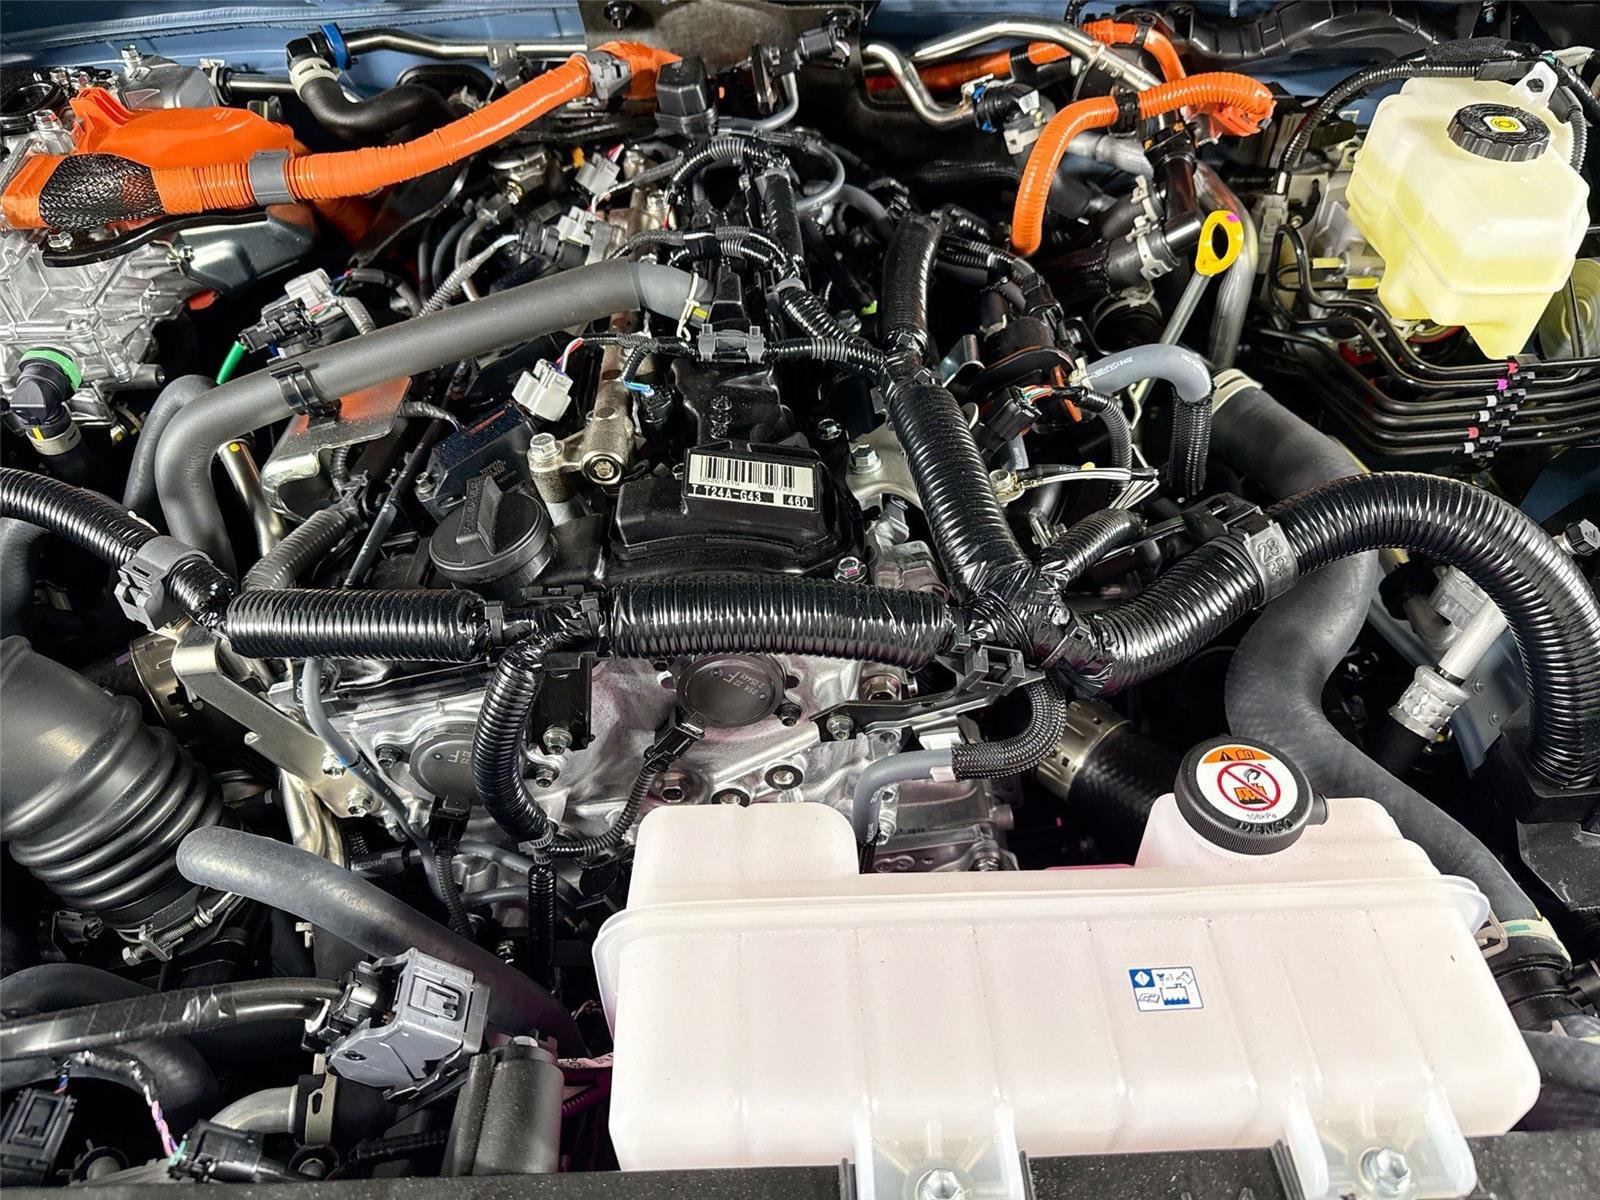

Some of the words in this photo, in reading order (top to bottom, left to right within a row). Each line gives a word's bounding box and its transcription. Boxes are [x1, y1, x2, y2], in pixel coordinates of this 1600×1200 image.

[692, 485, 698, 495] T
[704, 486, 762, 502] T24A-G43
[788, 496, 808, 508] 460
[447, 750, 460, 763] F
[1236, 817, 1294, 835] DENSO
